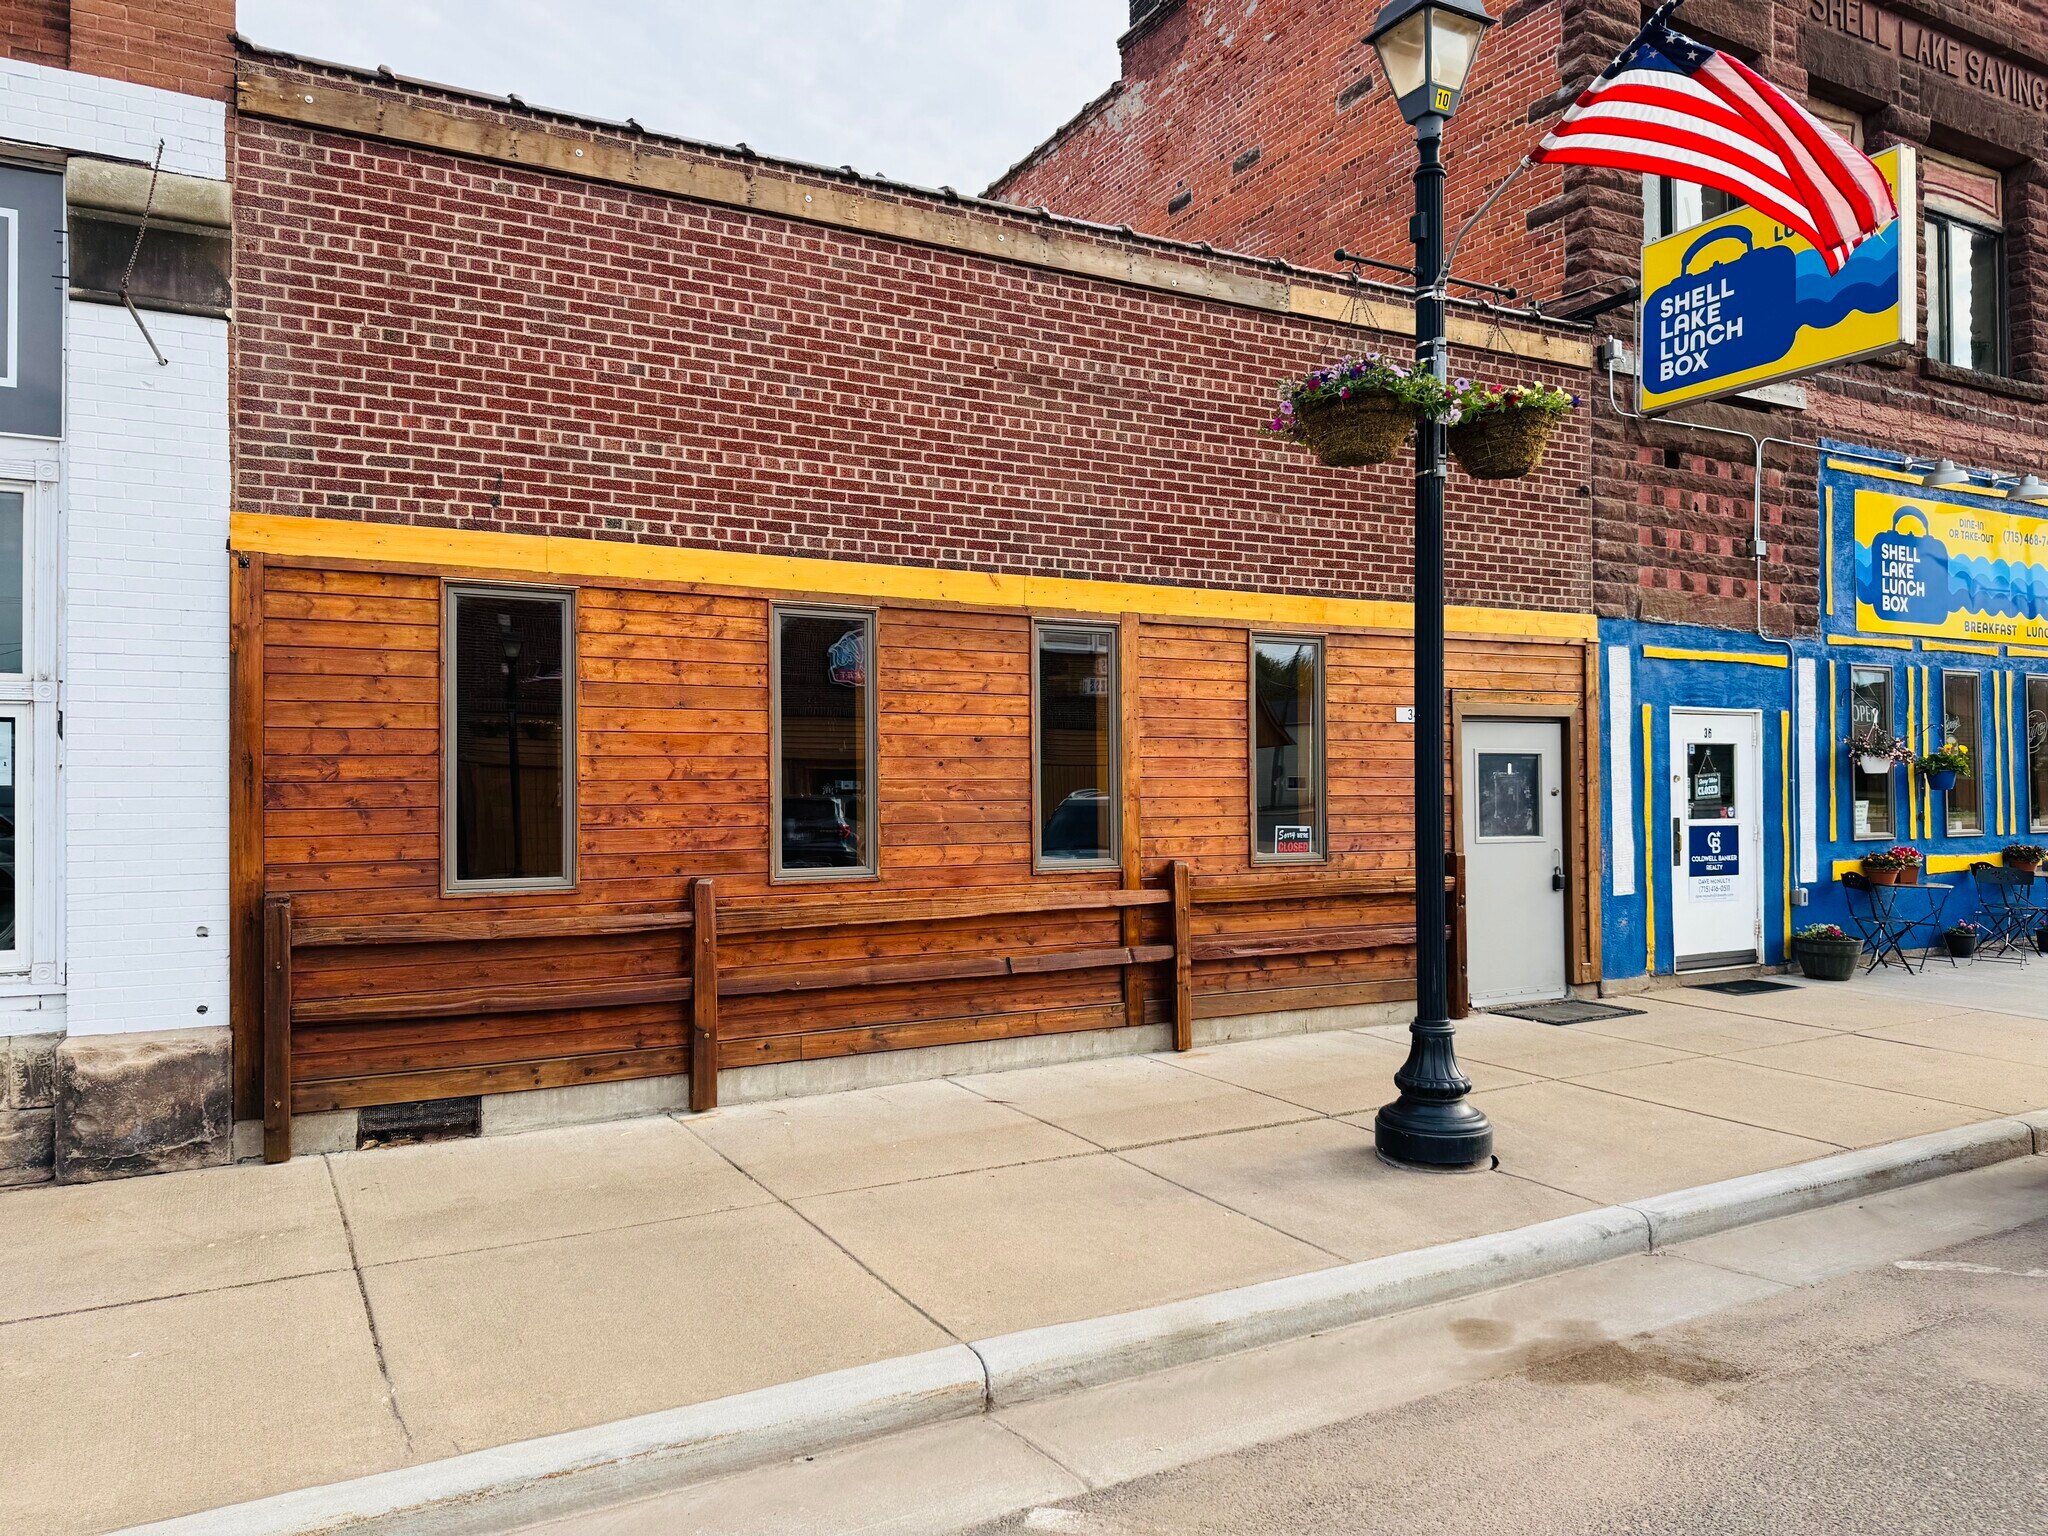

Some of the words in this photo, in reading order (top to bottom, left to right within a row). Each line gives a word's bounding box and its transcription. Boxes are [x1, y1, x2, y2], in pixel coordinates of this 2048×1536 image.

[1810, 0, 1892, 50] SHELL
[1899, 20, 1960, 77] LAKE
[1965, 50, 2048, 111] SAVING
[1438, 92, 1449, 107] 10
[1660, 278, 1735, 319] SHELL
[1660, 302, 1721, 340] LAKE
[1660, 317, 1743, 361] LUNCH
[1660, 349, 1709, 382] BOX
[1959, 518, 1985, 531] DINE-IN
[1949, 528, 1959, 539] OR
[1960, 530, 1994, 544] TAKE-OUT
[2024, 533, 2048, 547] 468-7
[1881, 543, 1921, 563] SHELL
[1881, 561, 1914, 579] LAKE
[1882, 578, 1925, 597] LUNCH
[1882, 597, 1909, 613] BOX
[1964, 620, 2017, 636] BREAKFAST
[1408, 709, 1415, 720] 3
[1704, 728, 1712, 738] 36
[1278, 830, 1296, 840] Sorry
[1278, 841, 1309, 852] CLOSED
